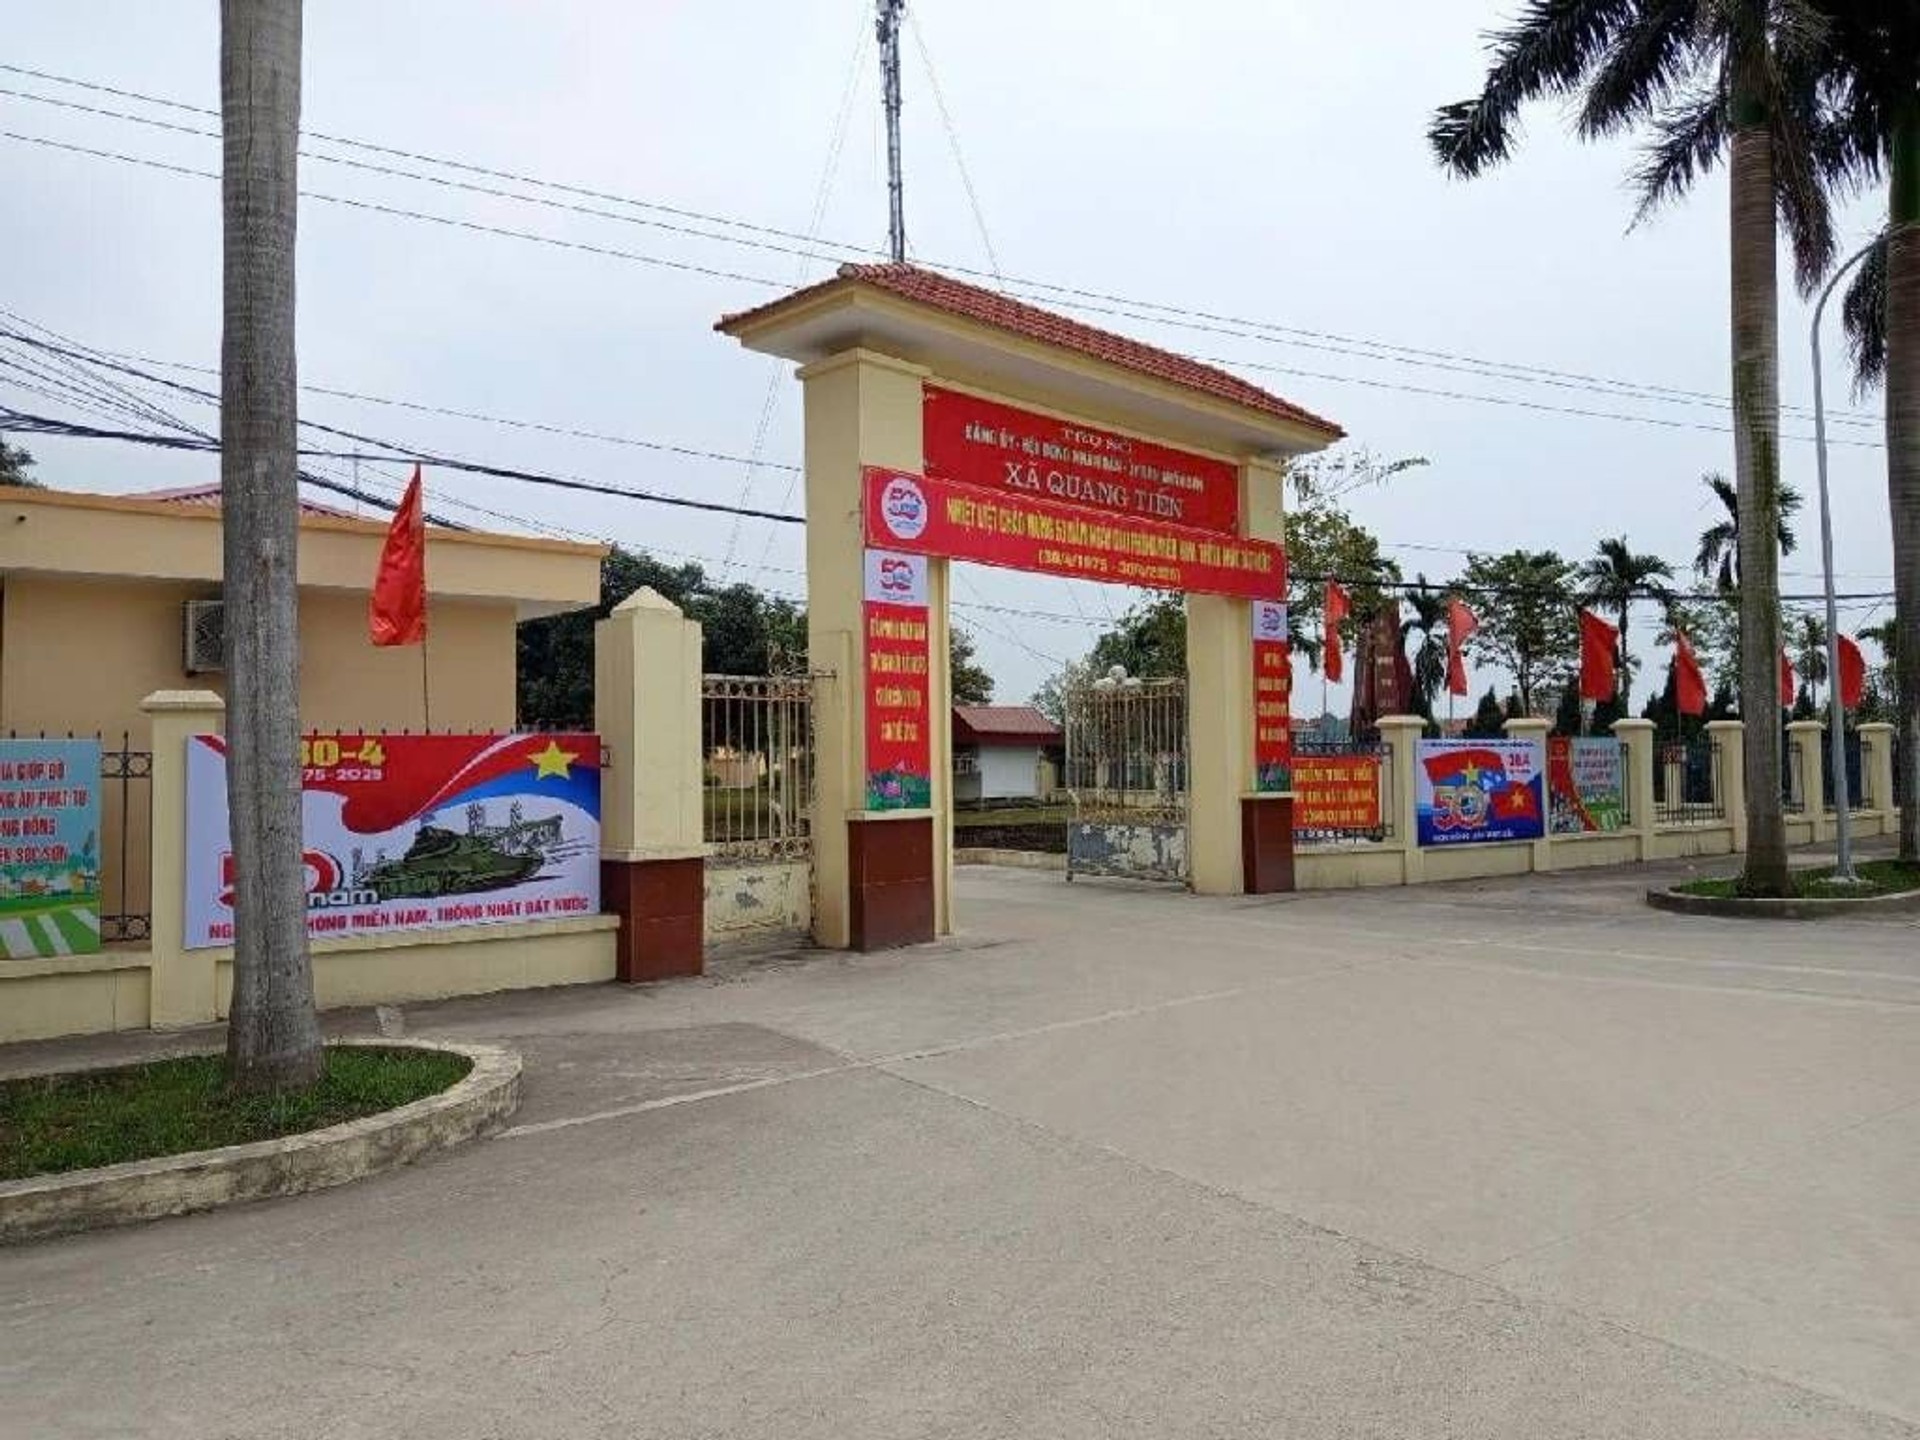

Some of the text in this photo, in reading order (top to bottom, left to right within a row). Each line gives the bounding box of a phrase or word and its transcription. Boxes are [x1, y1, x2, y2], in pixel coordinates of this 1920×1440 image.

[1004, 460, 1184, 518] XÃ QUANG TIẾN
[302, 768, 383, 781] 75-2025
[0, 819, 19, 837] NG
[209, 922, 232, 938] NG
[307, 914, 346, 933] HÓNG
[352, 907, 389, 928] MIỀN
[395, 908, 432, 925] NAM,
[437, 901, 482, 921] THỐNG
[487, 897, 520, 917] NHẤT
